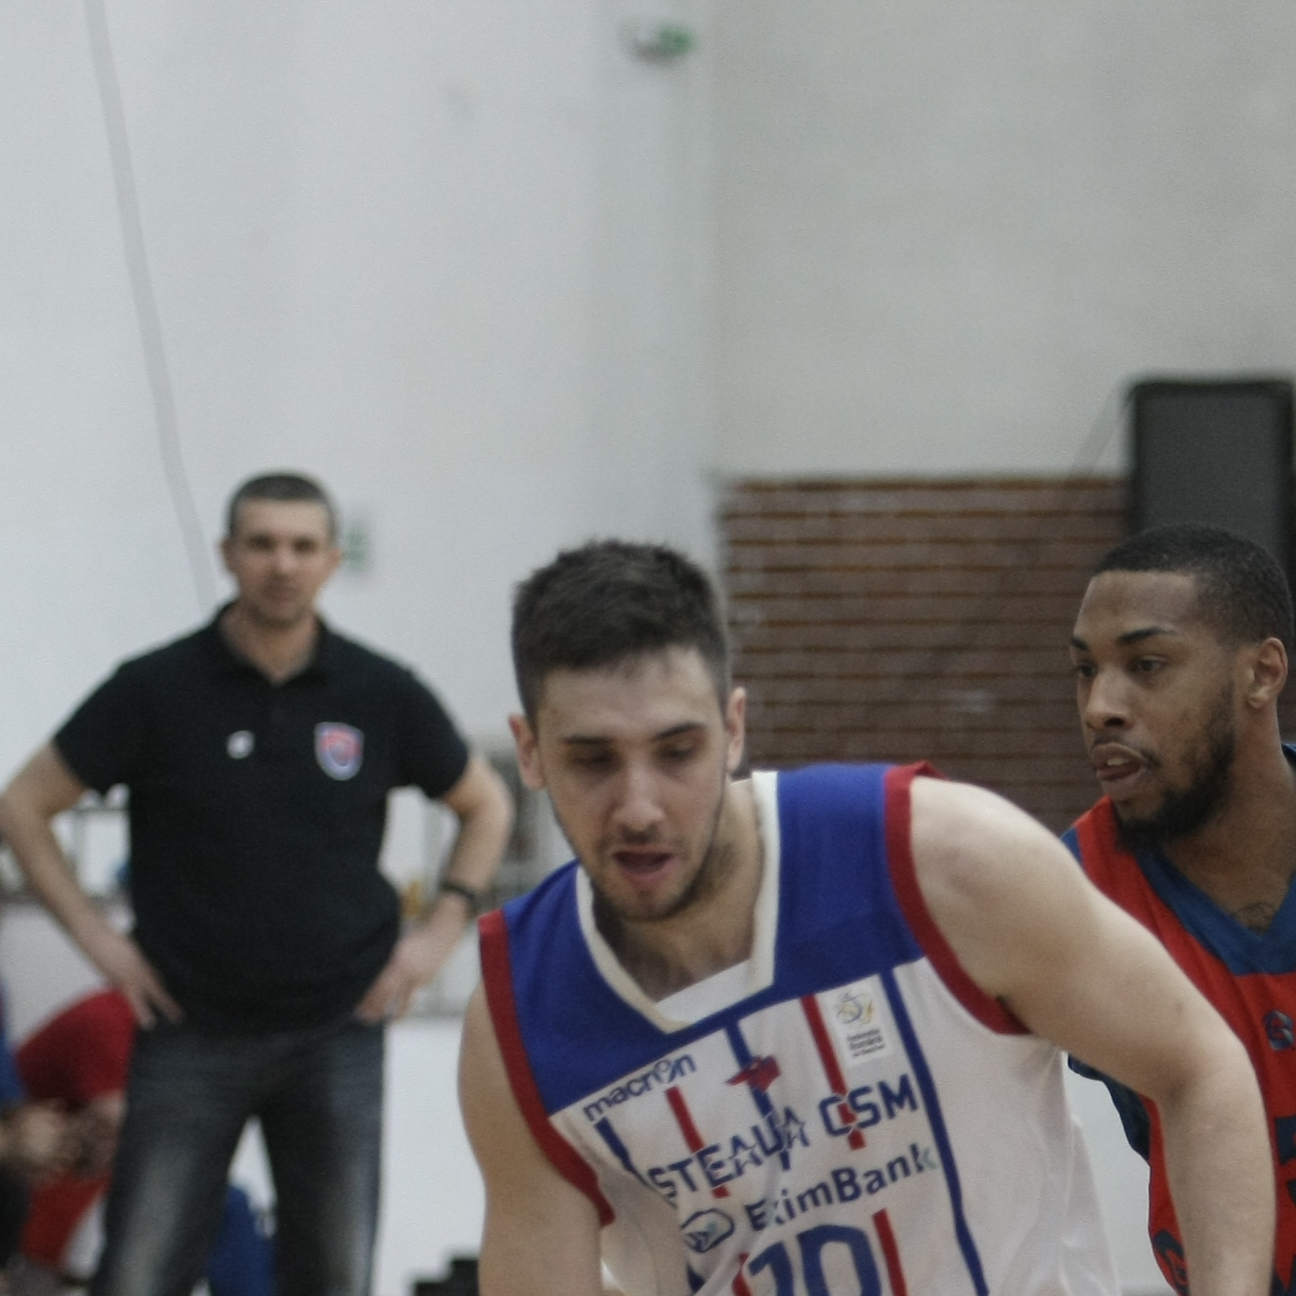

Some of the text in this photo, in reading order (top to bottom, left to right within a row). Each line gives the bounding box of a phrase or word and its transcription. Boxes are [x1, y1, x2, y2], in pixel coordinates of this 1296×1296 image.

[583, 1053, 697, 1121] macron
[647, 1073, 920, 1200] STEAUA CSM
[744, 1142, 941, 1232] EximBank
